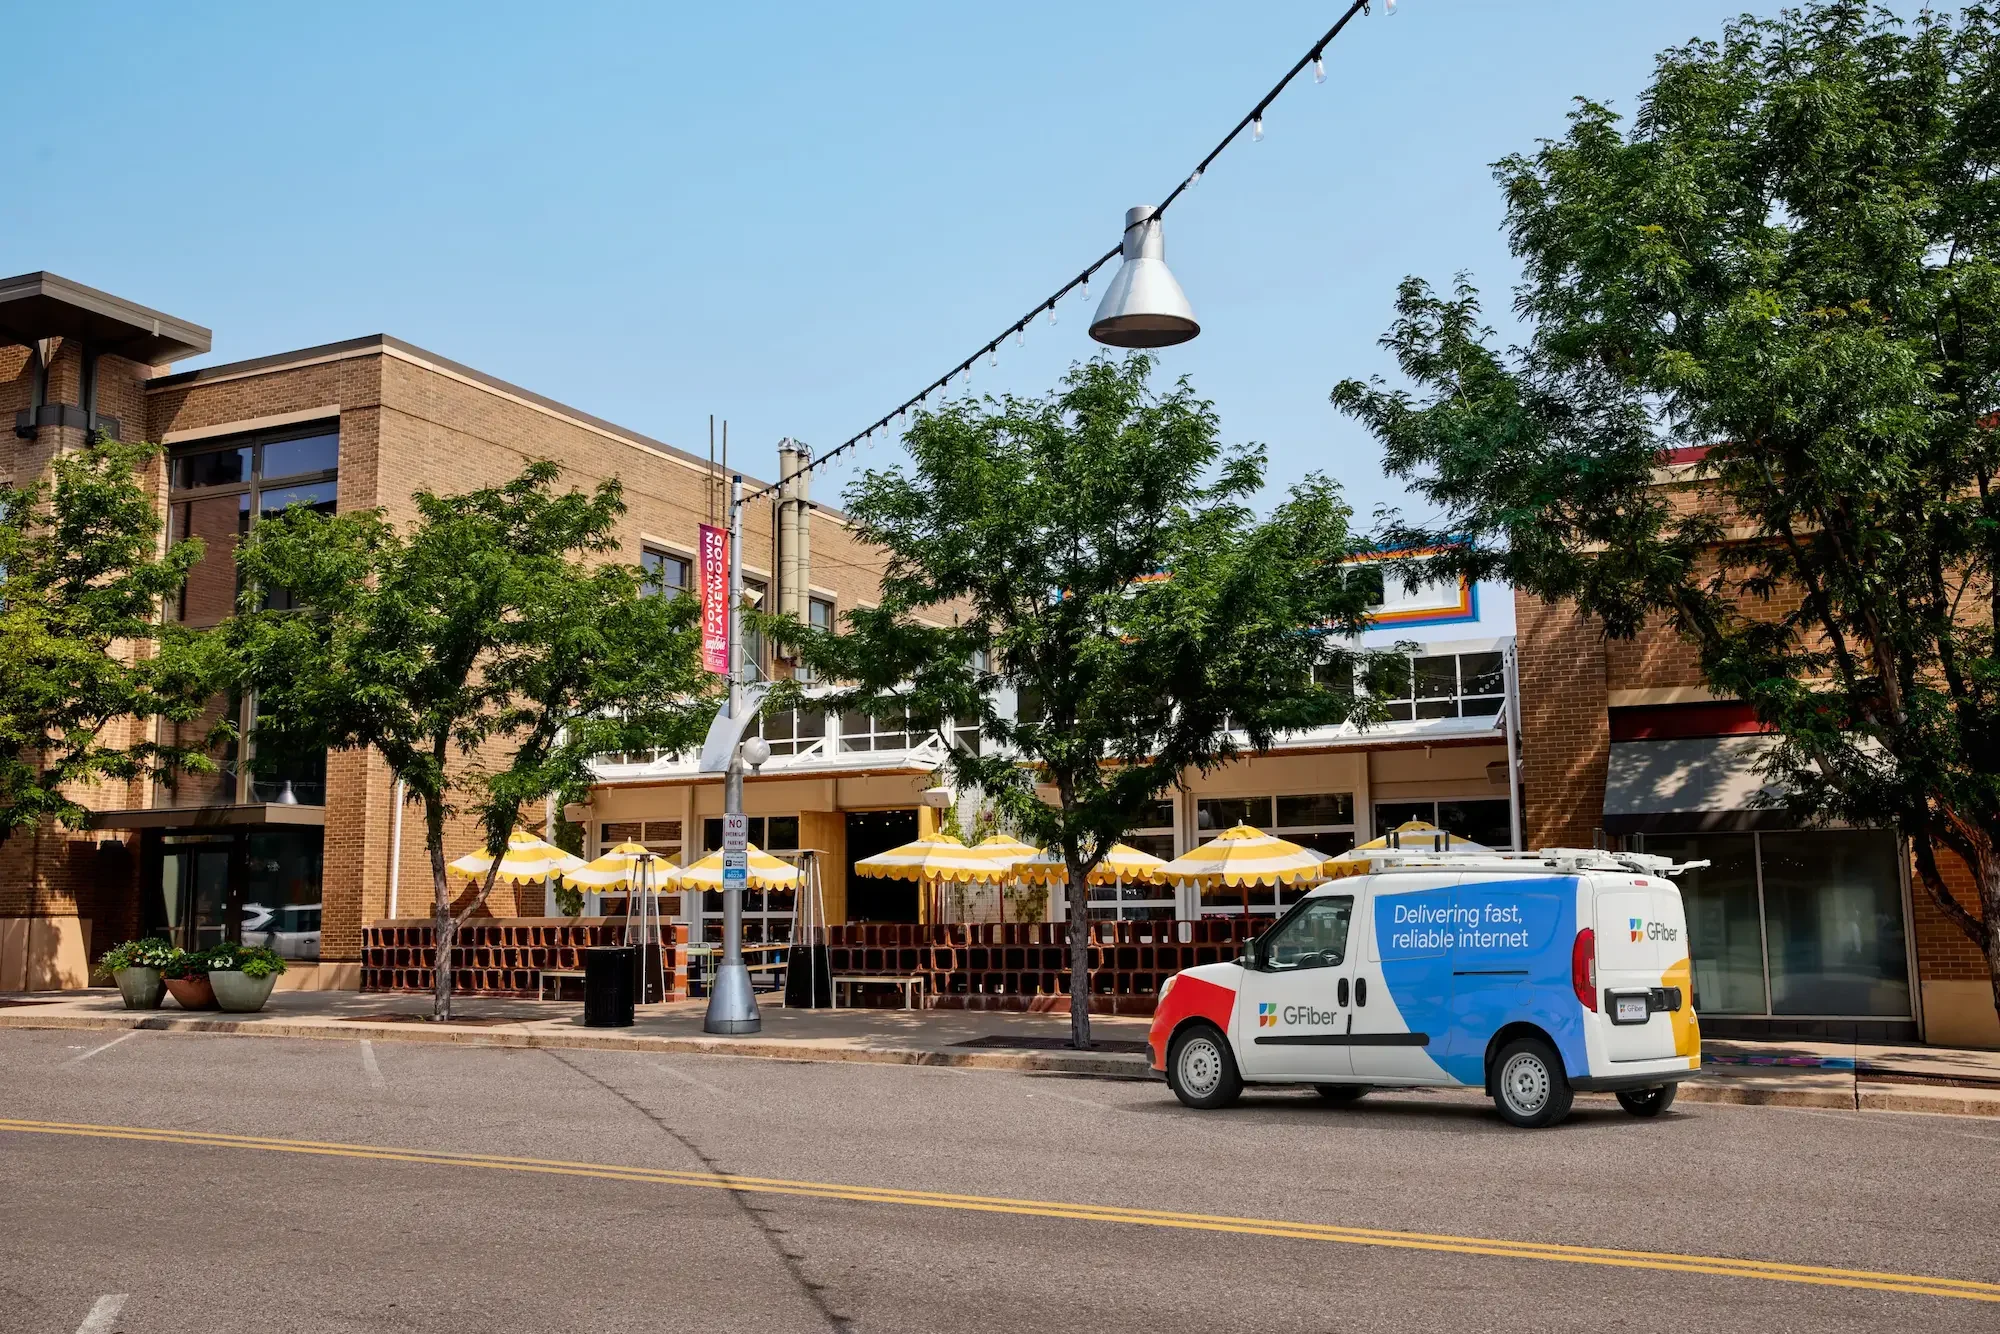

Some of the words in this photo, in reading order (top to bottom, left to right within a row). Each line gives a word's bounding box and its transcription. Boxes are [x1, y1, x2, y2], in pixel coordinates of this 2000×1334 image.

[706, 532, 715, 632] DOWNTOWN
[714, 535, 723, 635] LAKEWOOD
[729, 819, 742, 828] NO
[1394, 904, 1480, 928] Delivering
[1484, 903, 1522, 924] fast,
[1392, 929, 1454, 948] reliable
[1459, 929, 1528, 948] internet
[1646, 921, 1677, 941] GFiber
[1283, 1005, 1337, 1025] GFiber
[1627, 1004, 1644, 1012] GFiber
